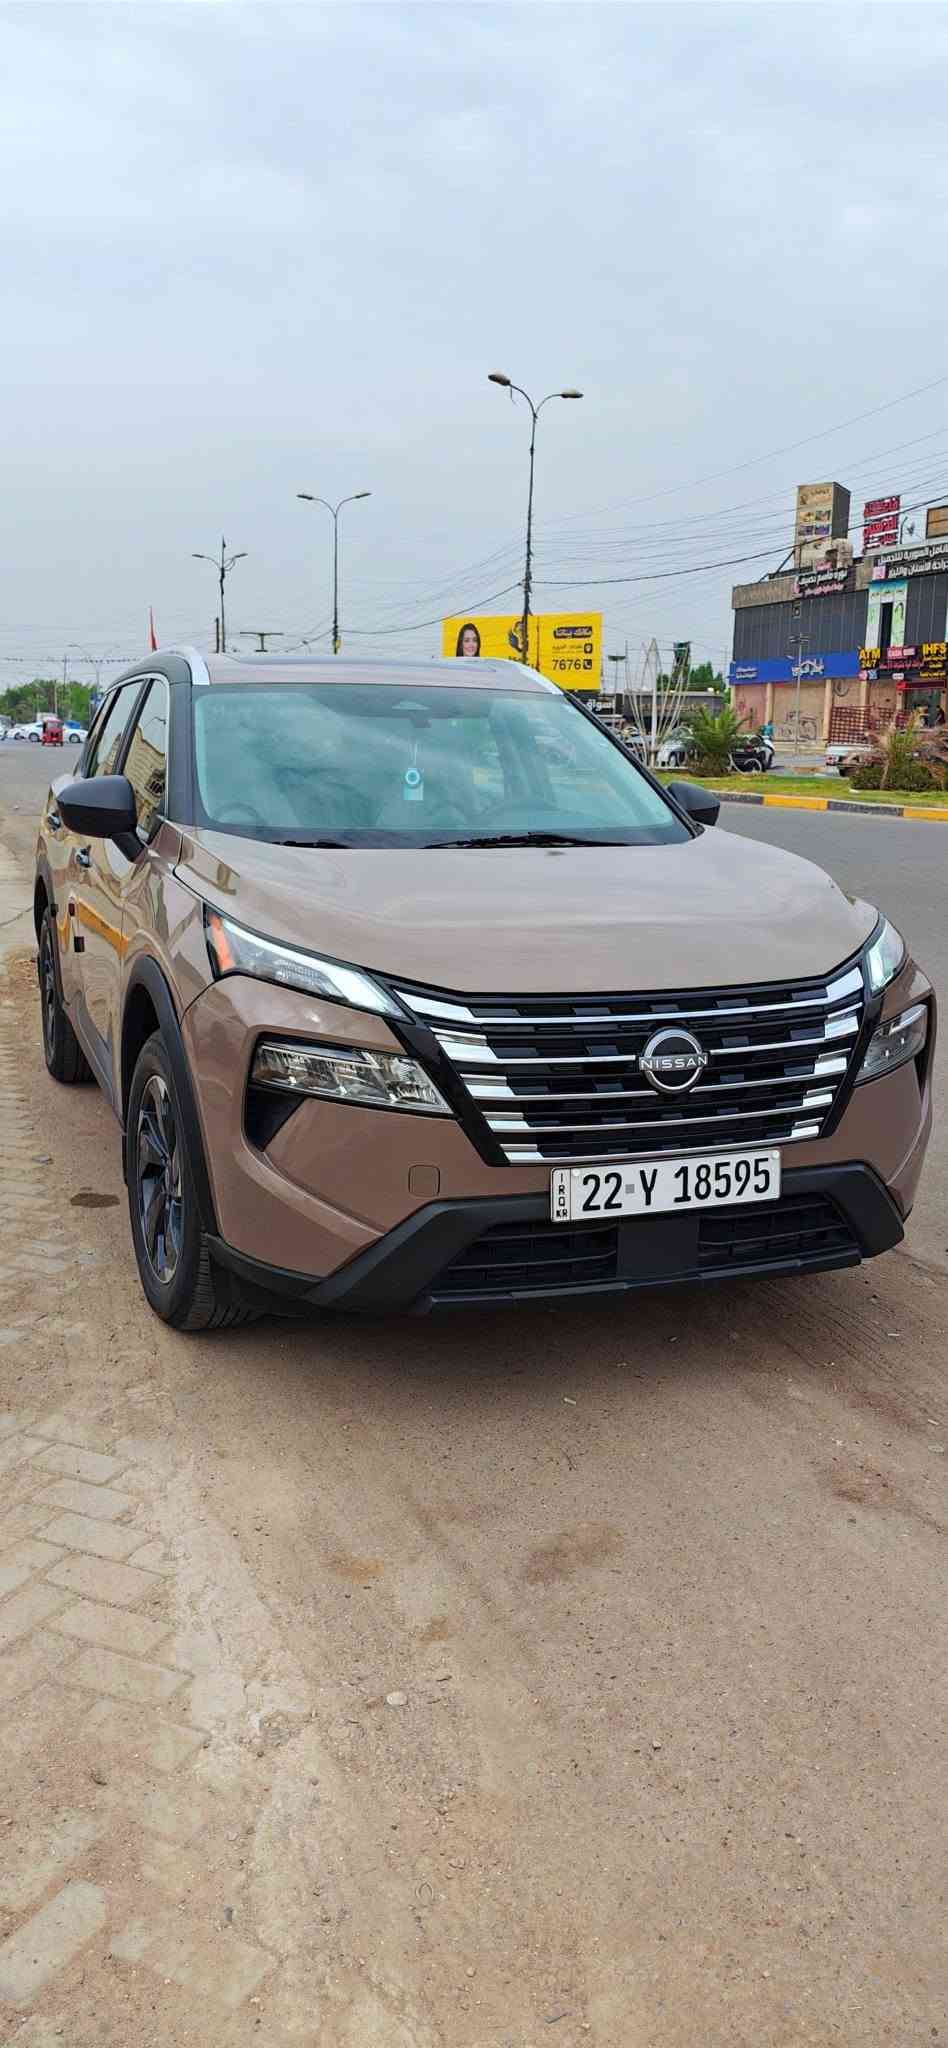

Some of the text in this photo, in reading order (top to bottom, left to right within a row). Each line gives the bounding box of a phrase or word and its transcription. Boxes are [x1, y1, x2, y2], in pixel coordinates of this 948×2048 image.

[860, 647, 880, 660] ATM
[552, 659, 581, 670] 7676
[640, 1056, 707, 1069] NISSAN
[582, 1172, 623, 1212] 22
[673, 1157, 770, 1203] 18595
